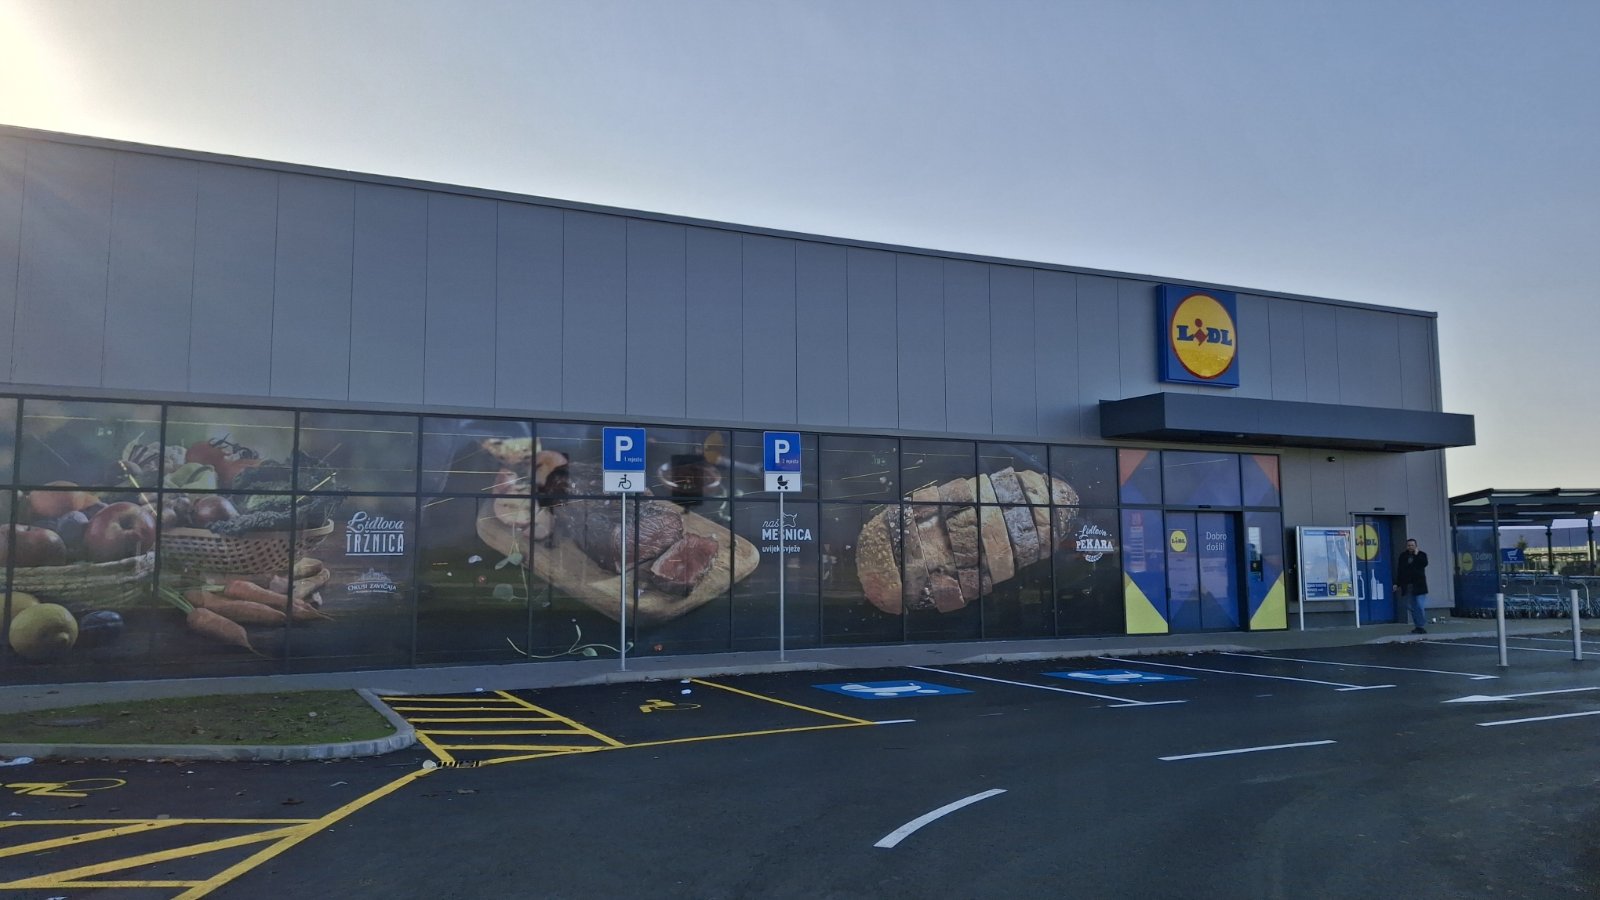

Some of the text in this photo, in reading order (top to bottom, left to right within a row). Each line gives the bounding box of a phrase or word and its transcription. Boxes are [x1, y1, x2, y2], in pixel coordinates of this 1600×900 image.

[1176, 318, 1232, 346] LIDL
[615, 435, 633, 462] P
[774, 439, 790, 464] P
[346, 511, 404, 532] Lidlova
[762, 518, 779, 527] naš
[1078, 524, 1107, 539] Lidlova
[1206, 531, 1227, 541] Dobro
[346, 530, 404, 552] TRŽNICA
[1076, 538, 1113, 549] PEKARA
[1206, 541, 1225, 551] došli!
[762, 545, 780, 554] uvijek
